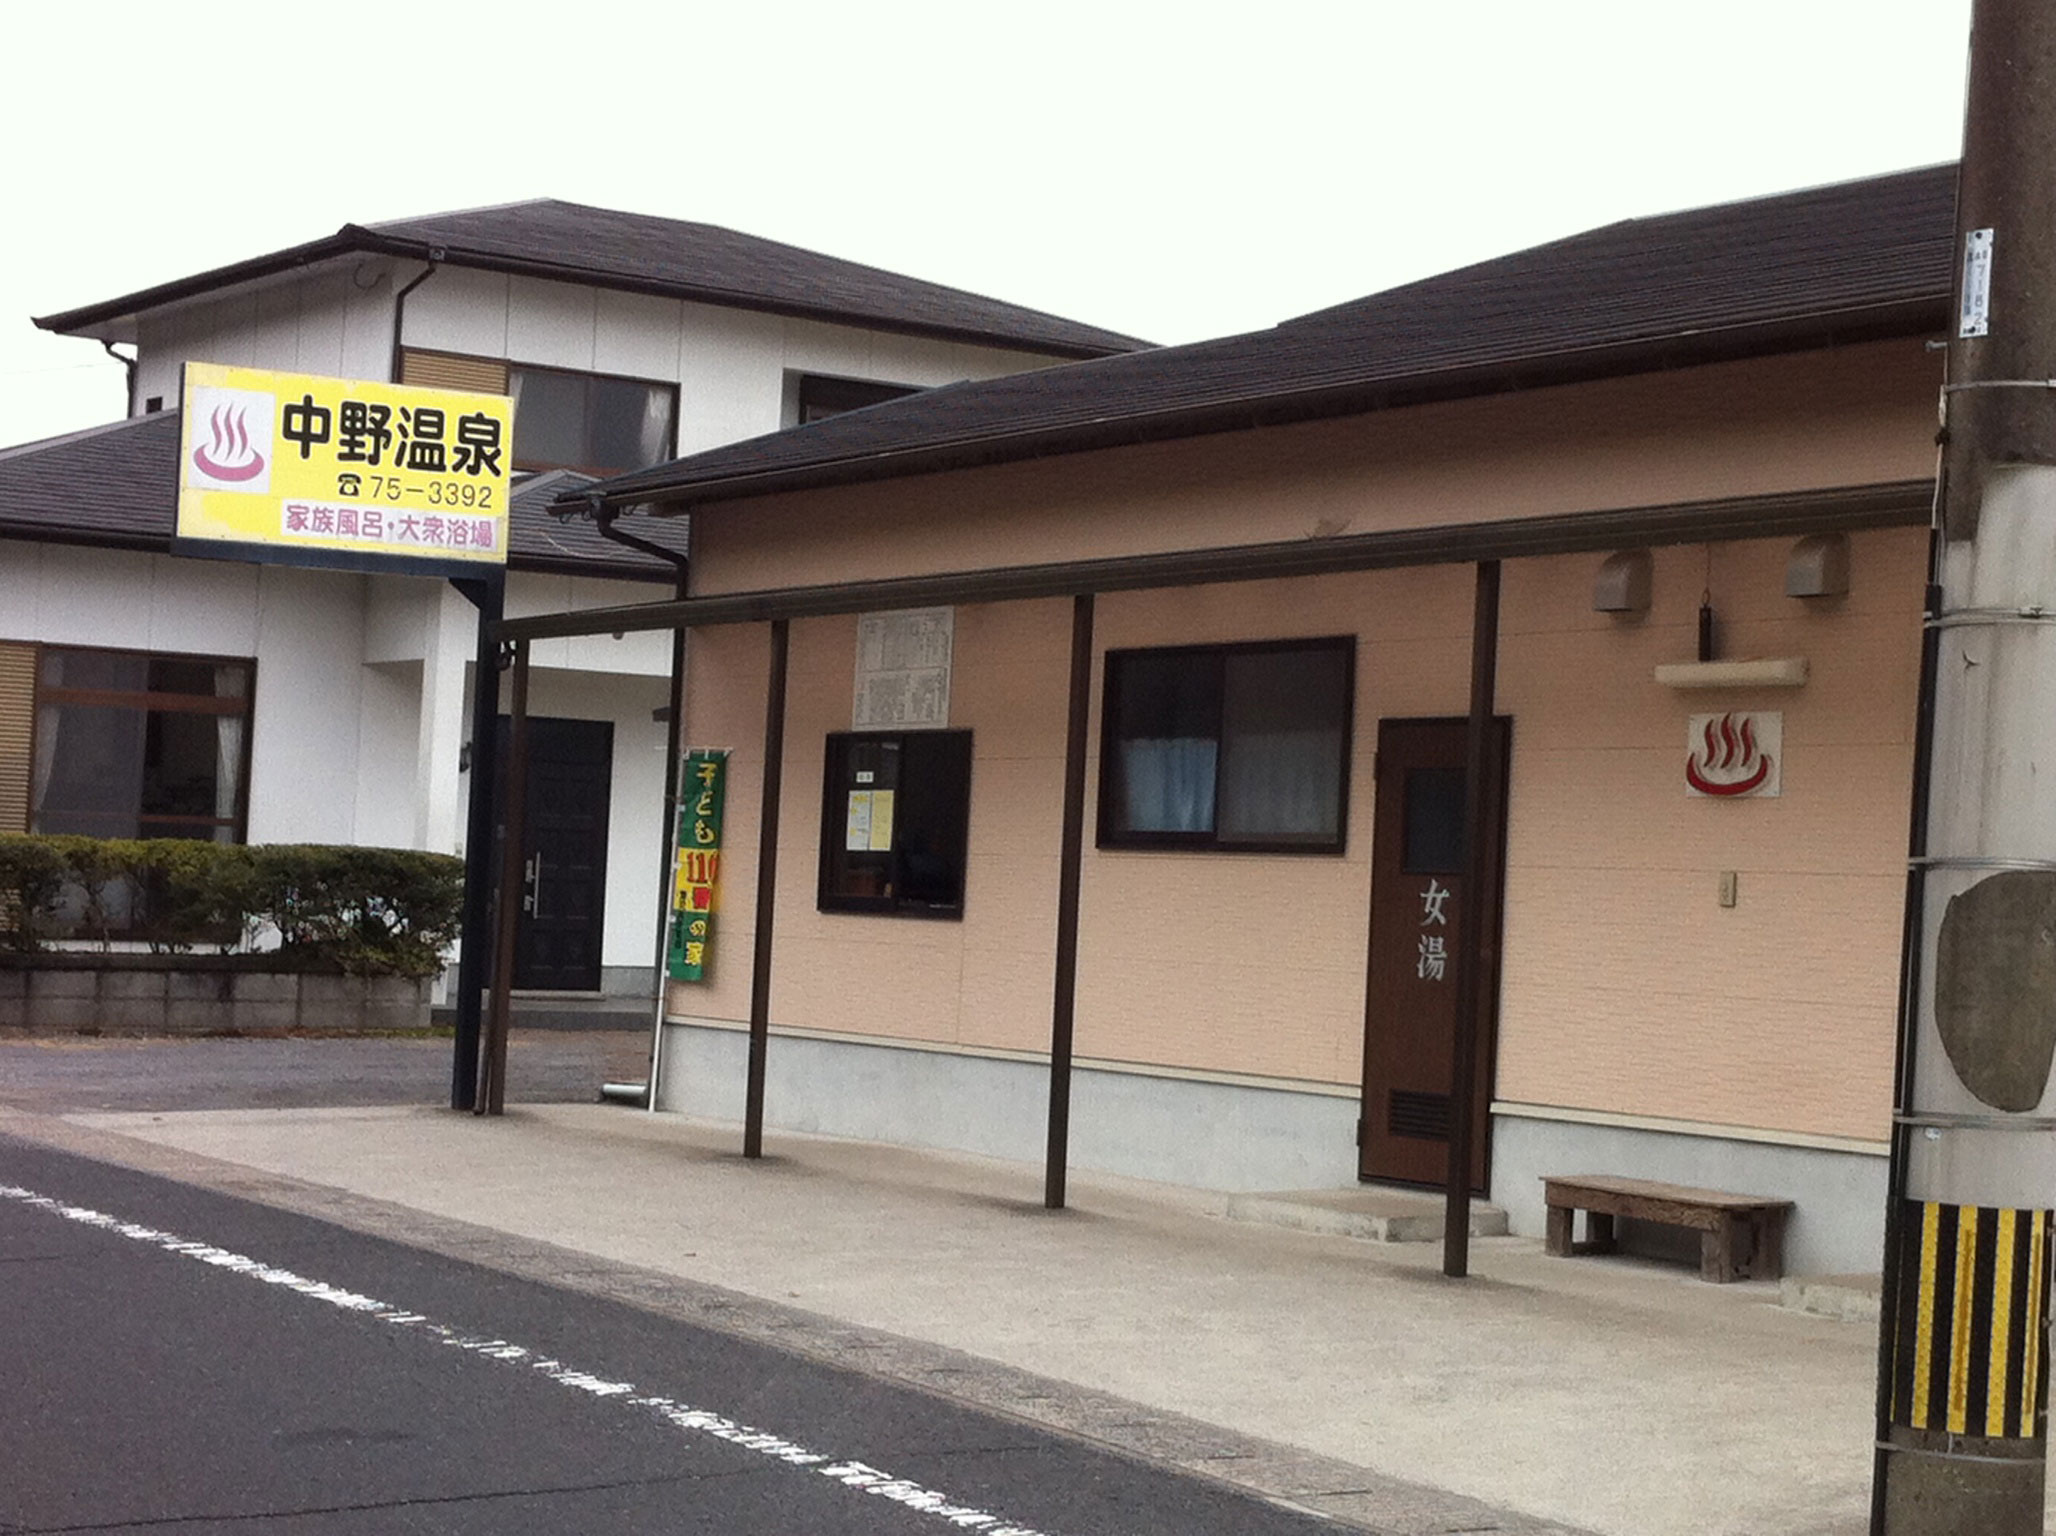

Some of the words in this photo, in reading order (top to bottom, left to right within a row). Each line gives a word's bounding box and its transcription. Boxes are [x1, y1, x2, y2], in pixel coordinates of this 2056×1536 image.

[282, 394, 502, 478] 中野温泉
[369, 475, 493, 509] 75-3392
[286, 504, 493, 548] 家族風呂・大衆浴場
[1416, 878, 1450, 982] 女湯
